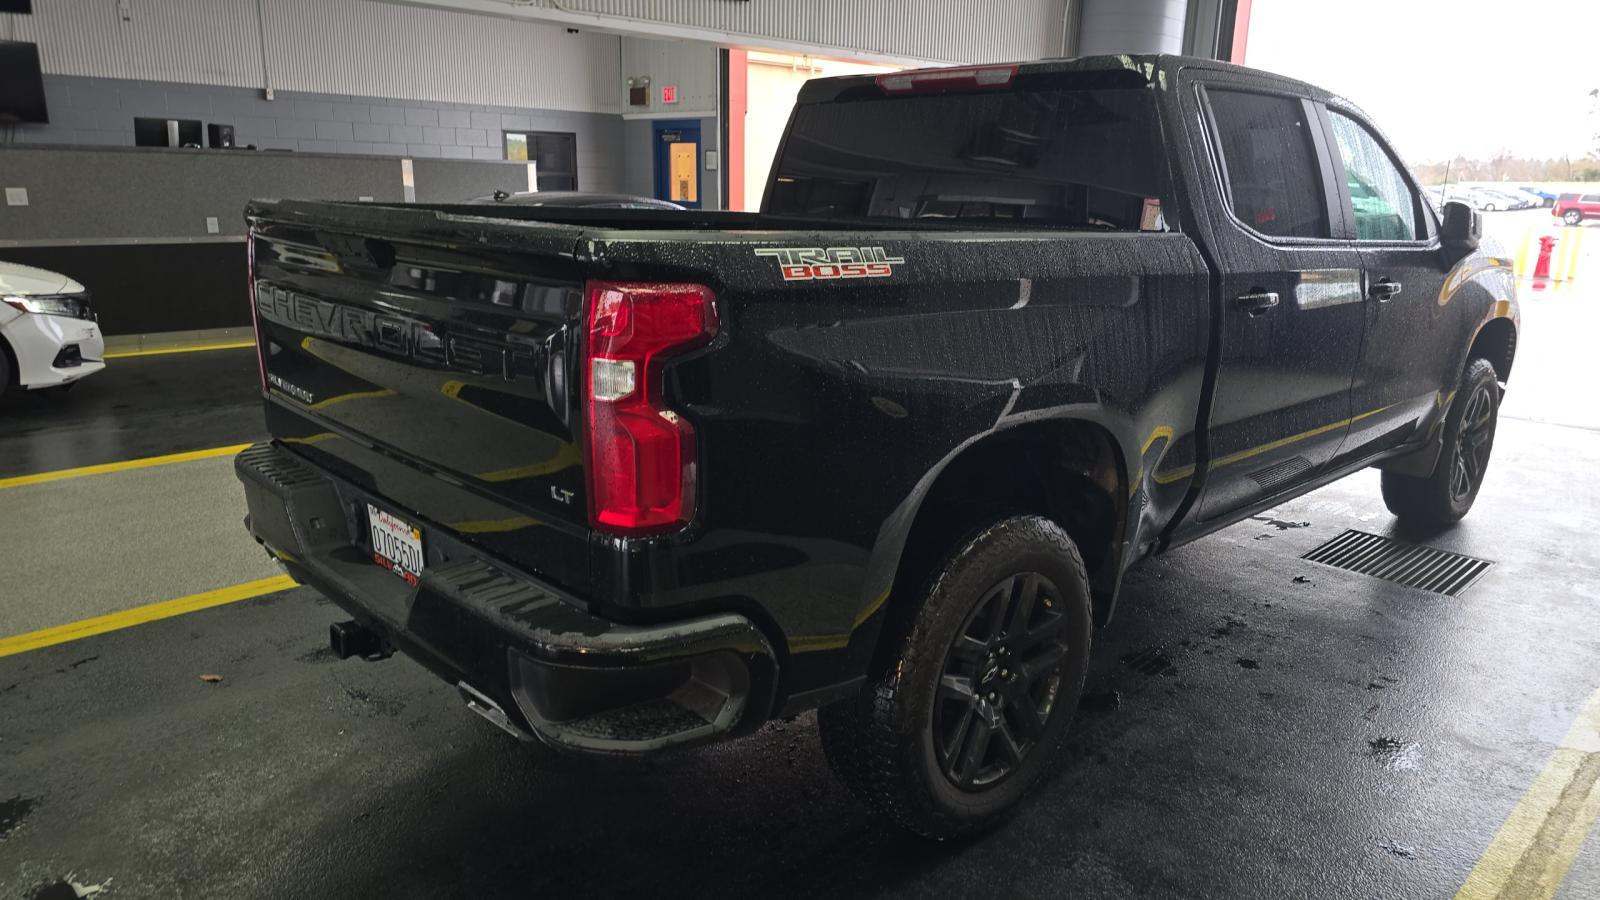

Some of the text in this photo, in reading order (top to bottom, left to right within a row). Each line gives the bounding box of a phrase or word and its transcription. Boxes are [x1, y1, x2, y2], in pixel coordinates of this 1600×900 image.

[754, 247, 905, 264] TRAIL
[781, 263, 892, 280] BOSS
[256, 280, 541, 383] CHEVROLET
[550, 485, 575, 505] LT
